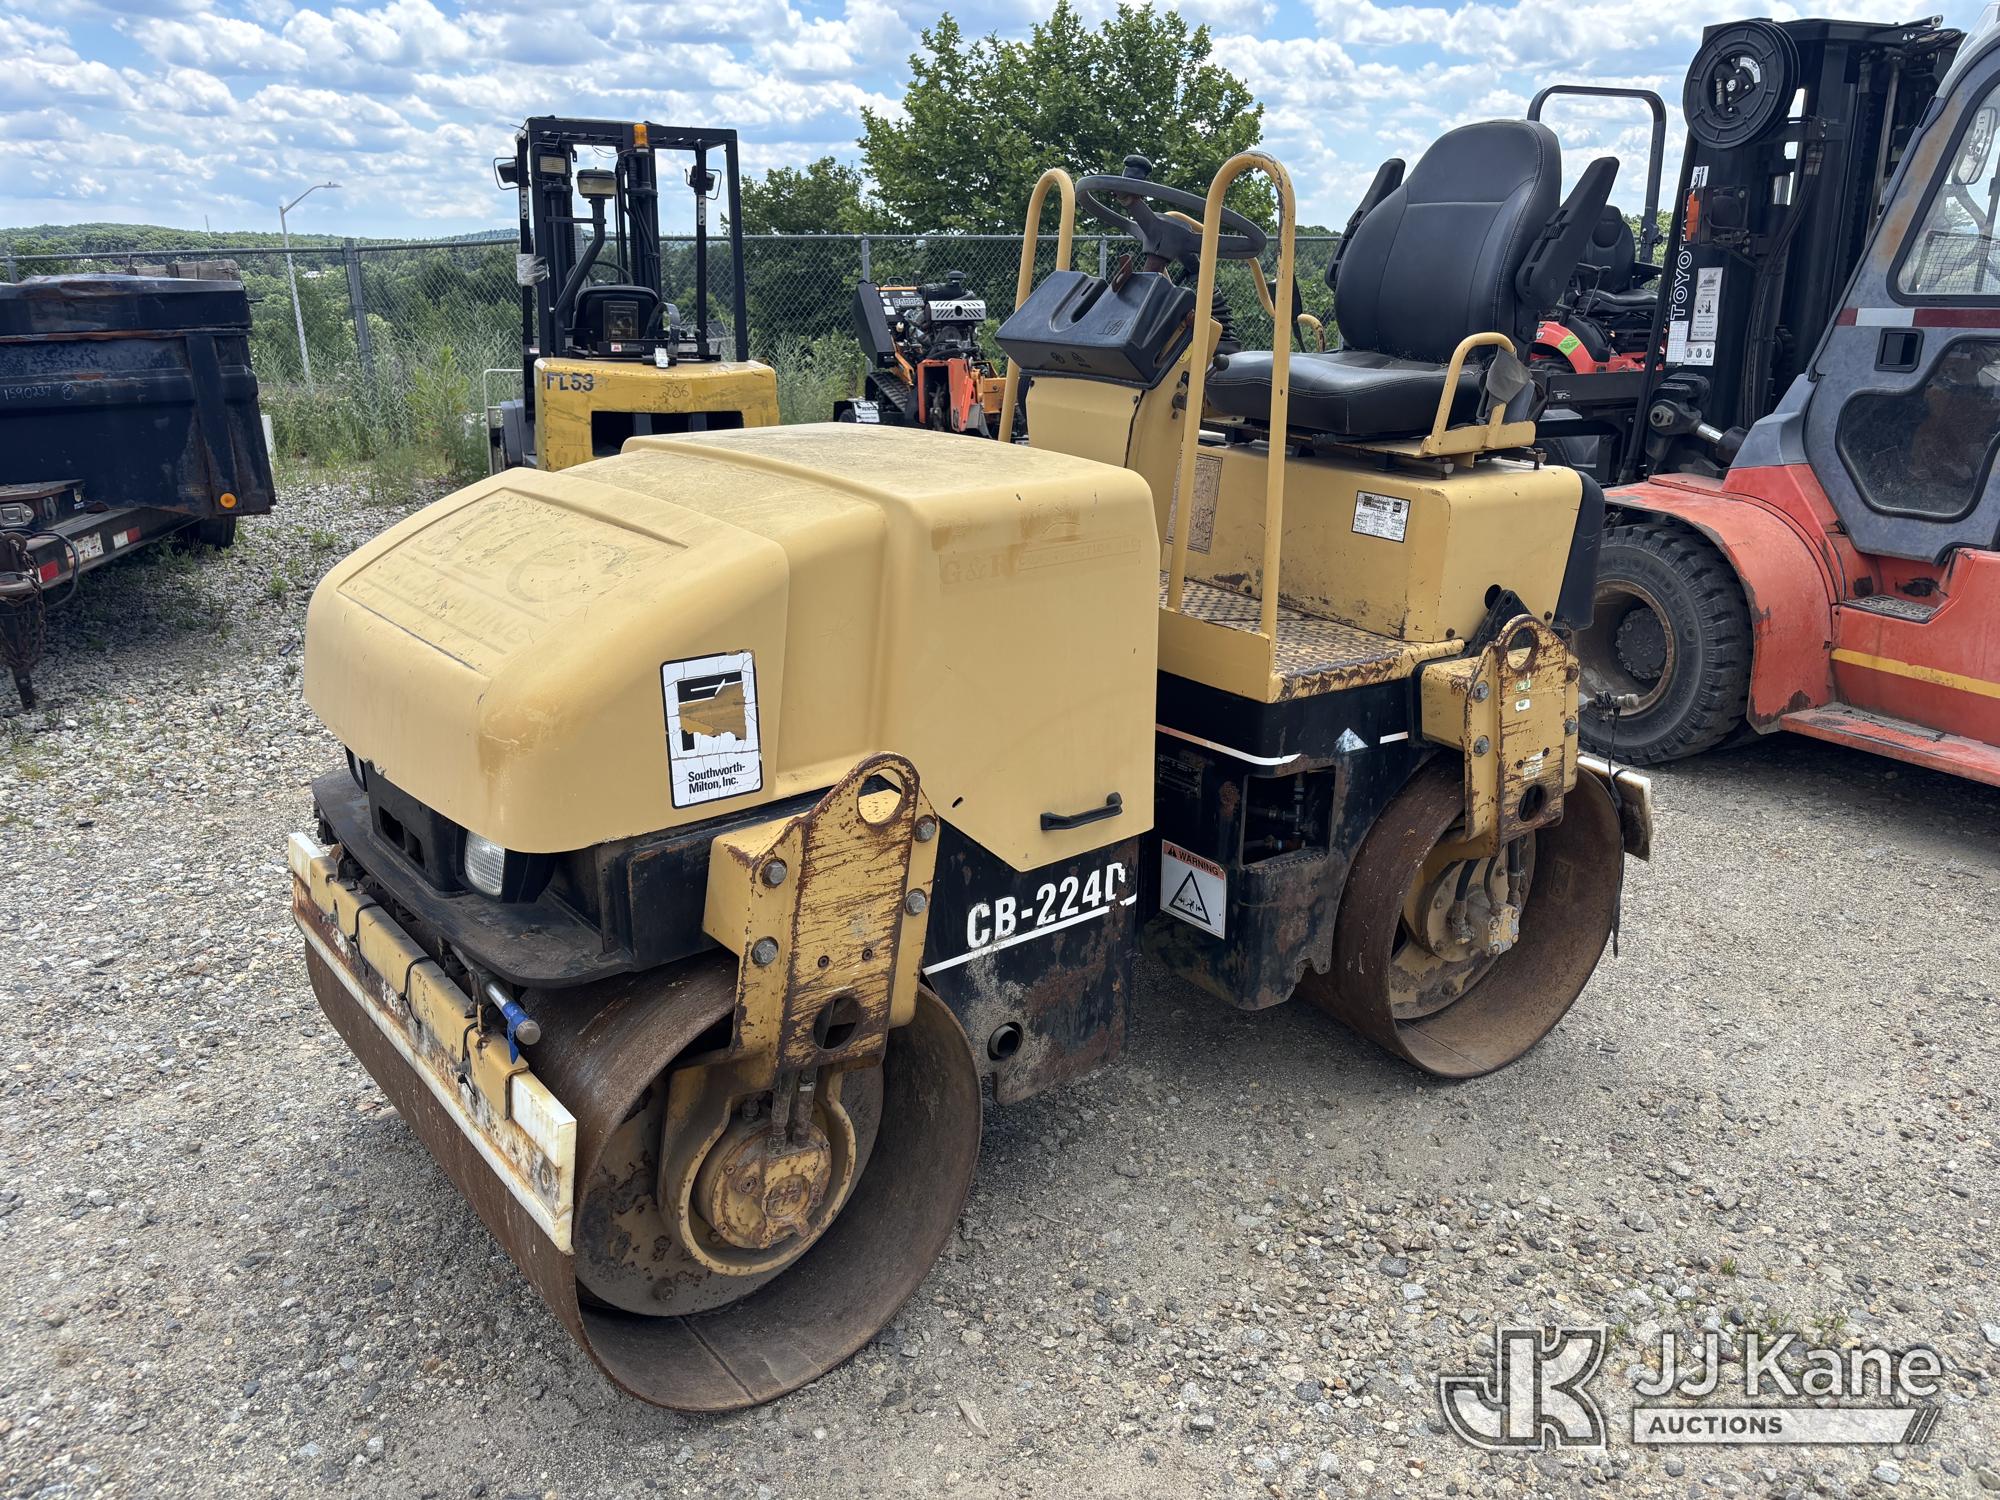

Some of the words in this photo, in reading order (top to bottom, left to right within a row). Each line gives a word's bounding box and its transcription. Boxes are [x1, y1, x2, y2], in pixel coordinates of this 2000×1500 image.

[1670, 217, 1692, 320] TOYO
[547, 372, 594, 391] FL53
[688, 761, 746, 783] Southworth-
[688, 778, 722, 794] Milton,
[722, 775, 739, 788] Inc.
[1178, 849, 1219, 876] WARNING
